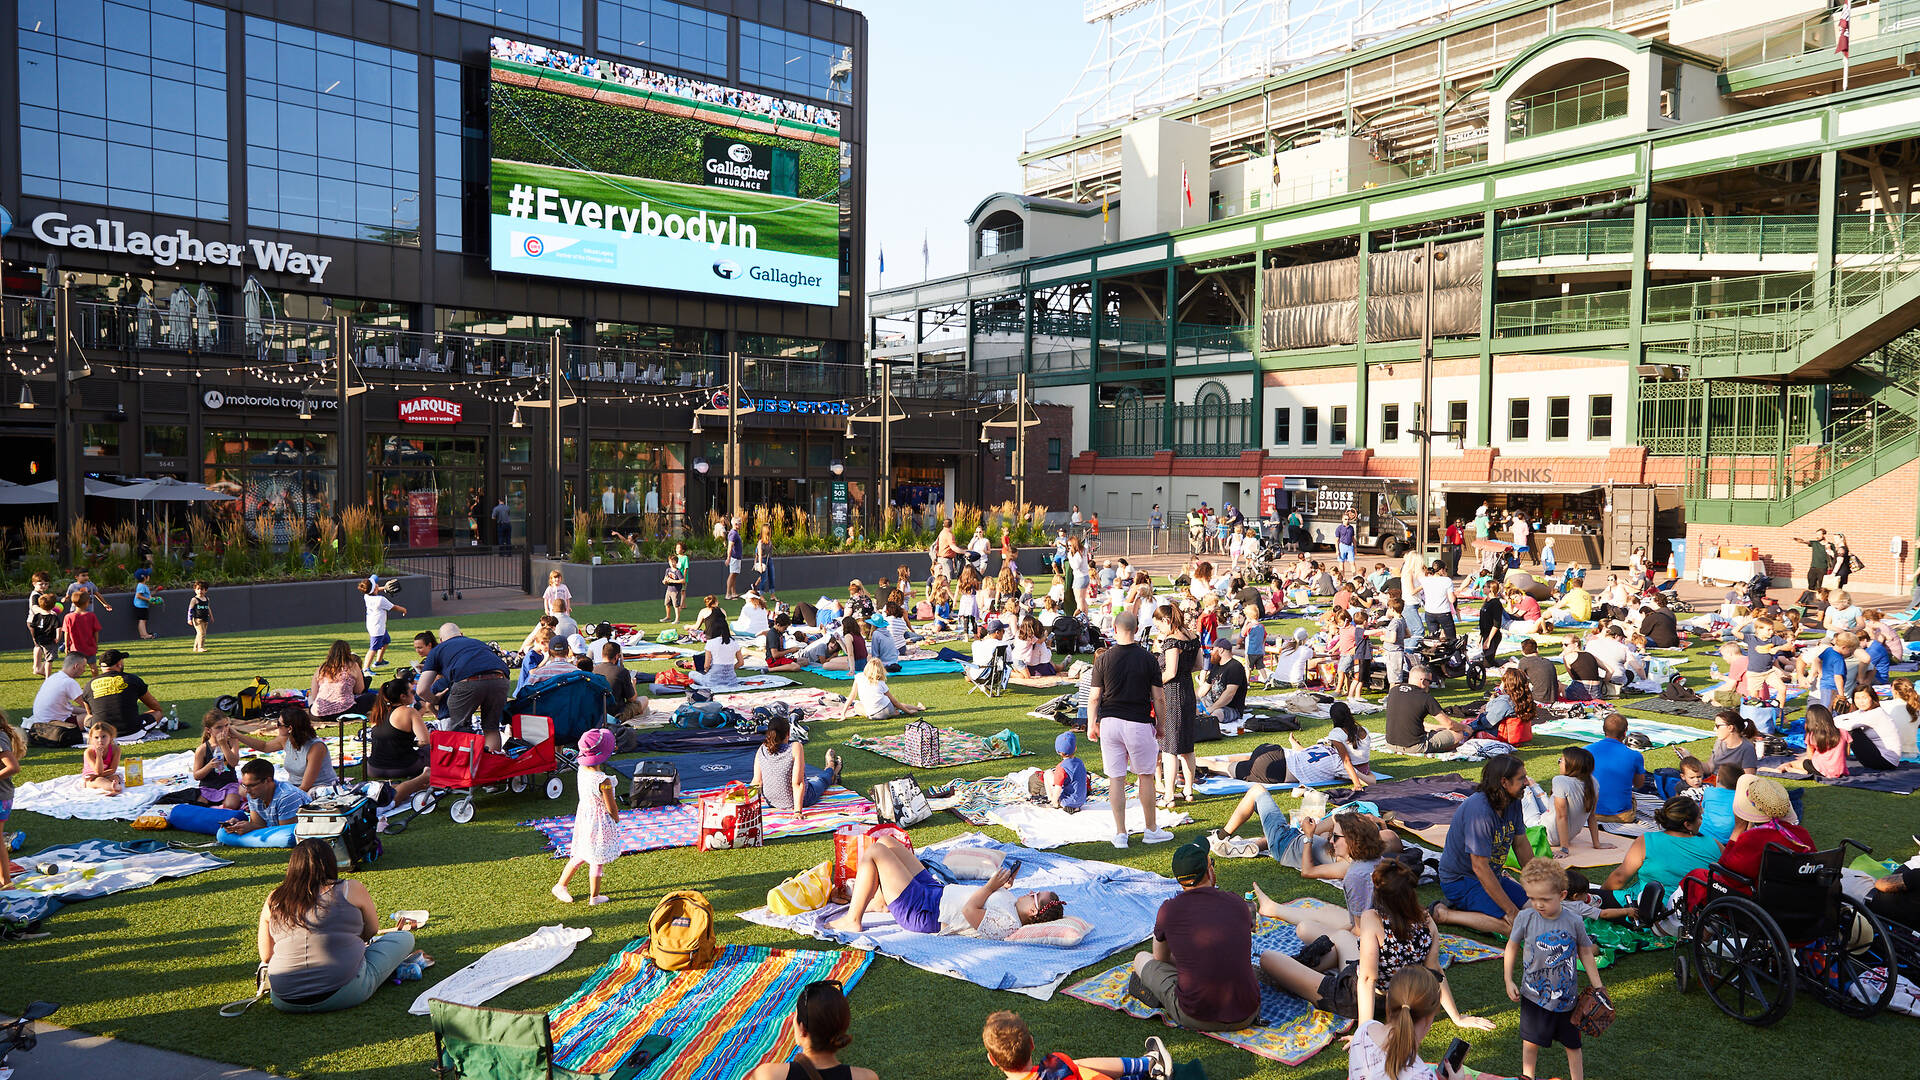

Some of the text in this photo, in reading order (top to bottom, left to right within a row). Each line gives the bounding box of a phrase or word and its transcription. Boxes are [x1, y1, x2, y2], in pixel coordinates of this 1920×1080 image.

[706, 158, 770, 180] Gallagher
[714, 176, 761, 190] INSURANCE
[508, 184, 757, 250] #EverybodyIn
[31, 212, 332, 284] Gallagher Way
[749, 266, 822, 287] Gallagher
[225, 395, 280, 407] motorola
[400, 399, 461, 416] MARQUEE
[797, 400, 850, 416] STORE
[1491, 468, 1552, 483] DRINKS
[1319, 490, 1354, 501] SMOKE
[1318, 500, 1354, 511] DADDY
